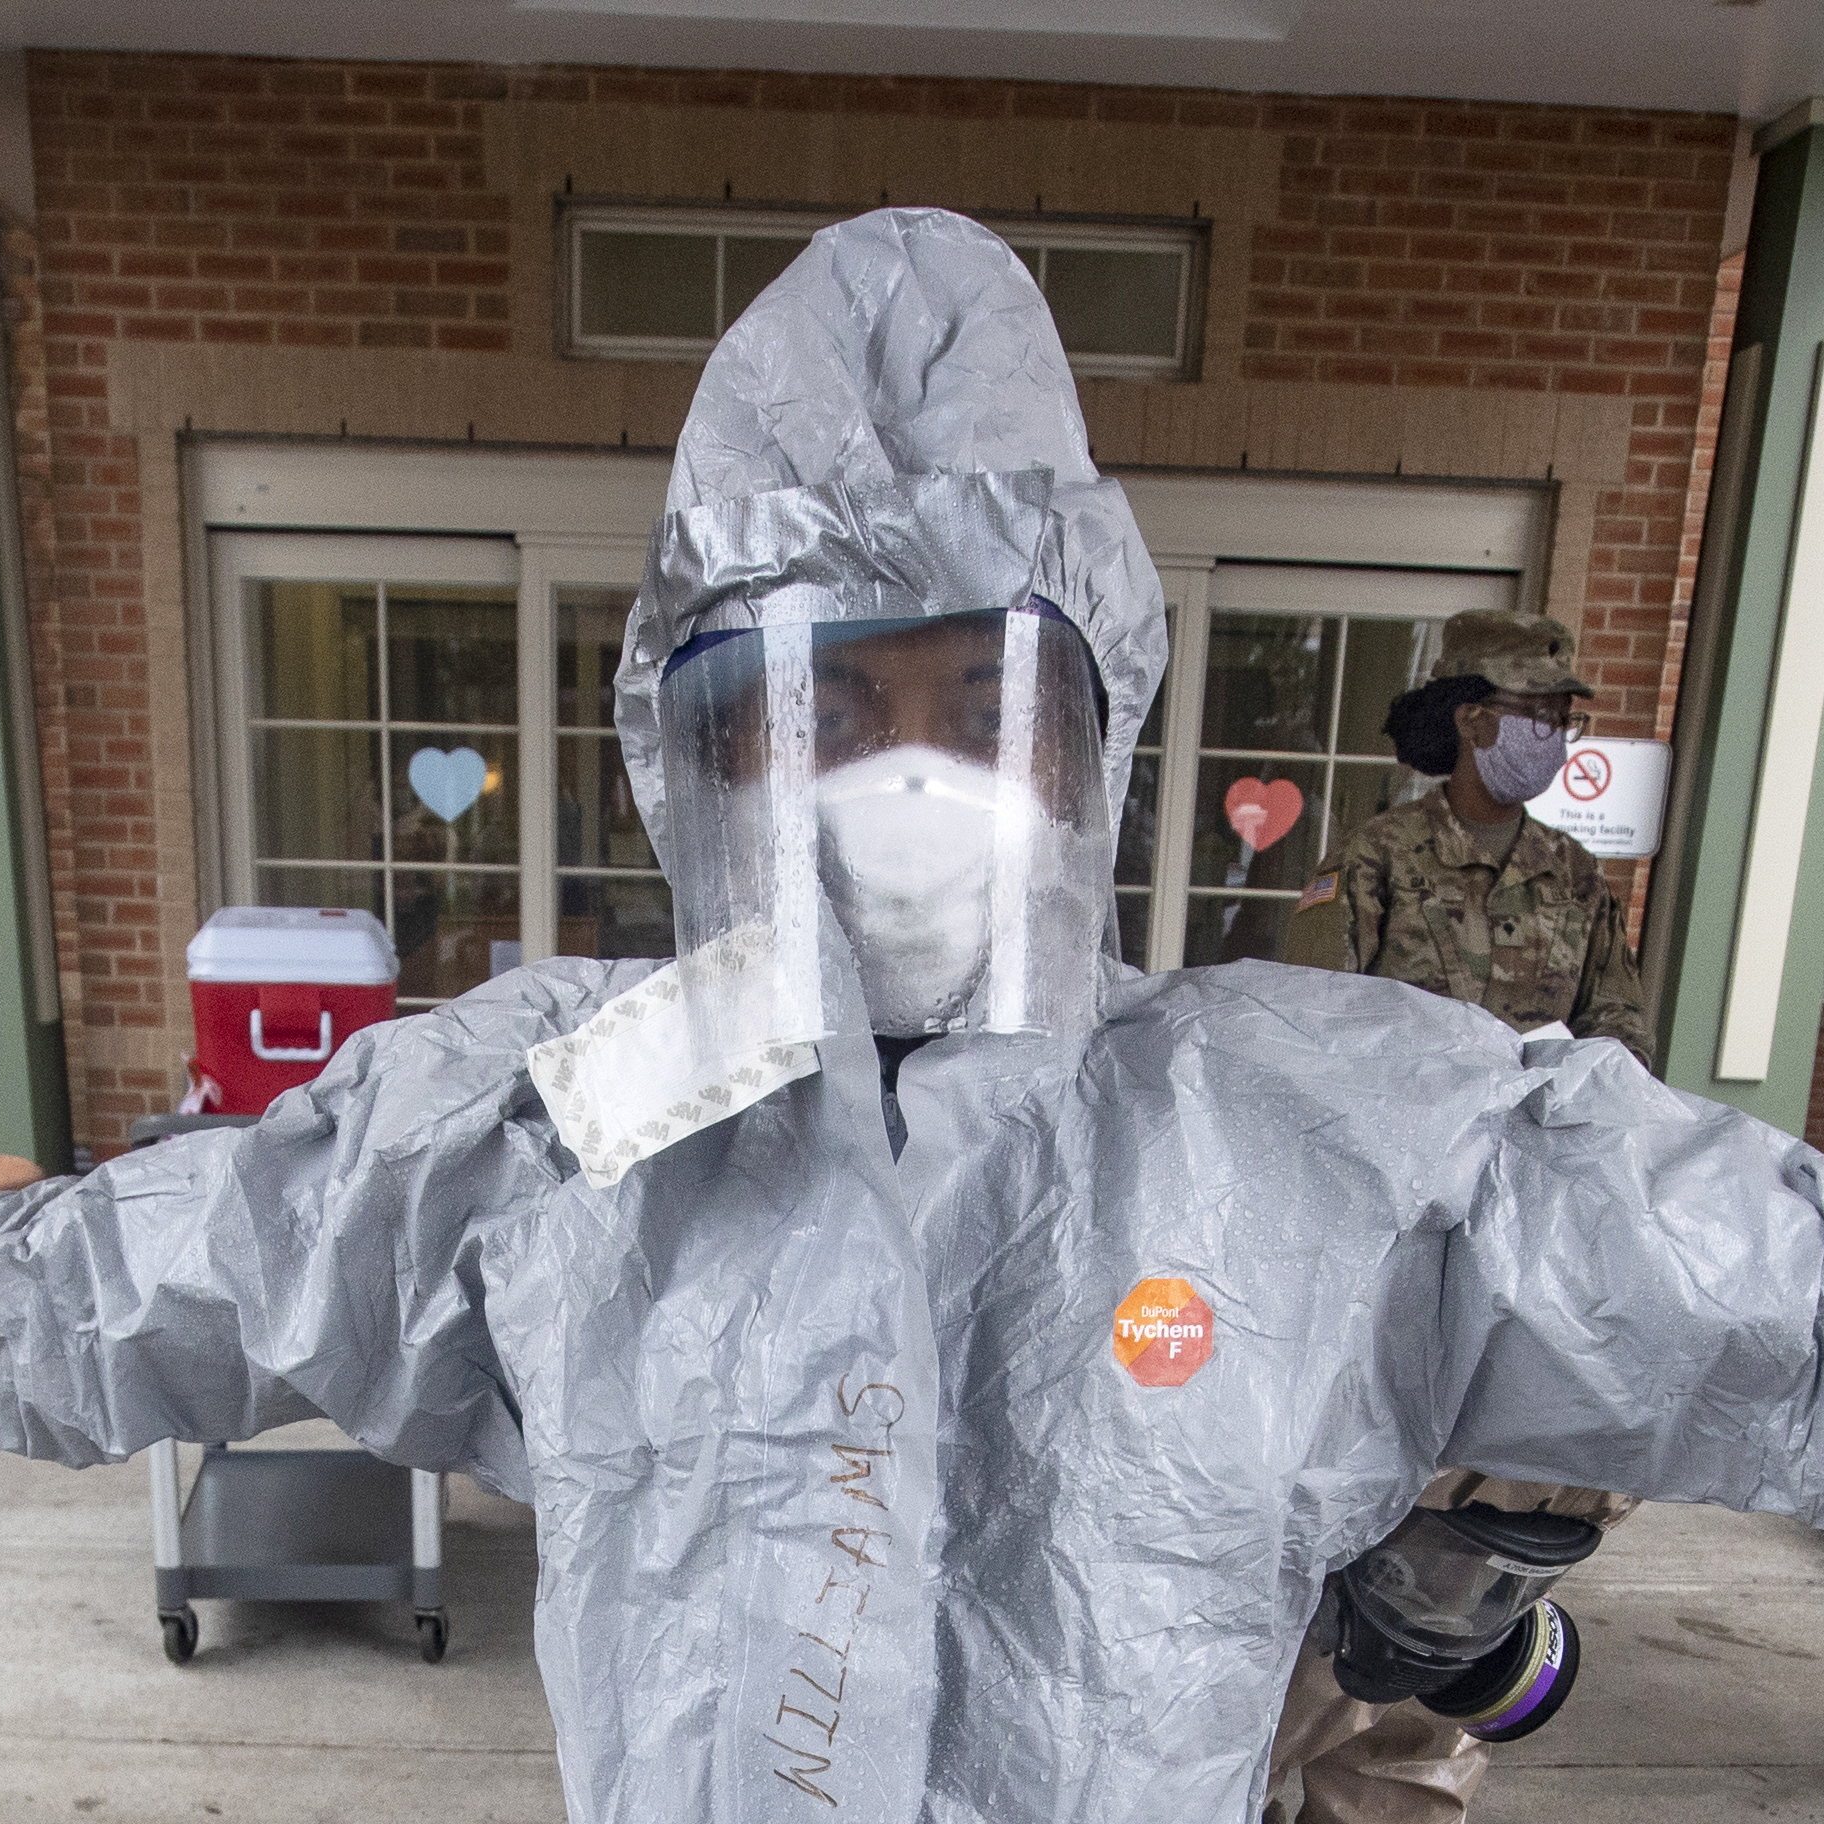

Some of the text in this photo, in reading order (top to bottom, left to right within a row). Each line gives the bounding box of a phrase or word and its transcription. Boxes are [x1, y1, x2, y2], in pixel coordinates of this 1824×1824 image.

[1600, 823, 1636, 837] facility
[613, 1000, 648, 1020] 3M
[645, 980, 680, 1002] 3M
[636, 1120, 670, 1141] 3M
[667, 1101, 703, 1123] 3M
[698, 1084, 732, 1107] 3M
[728, 1067, 763, 1087] 3M
[759, 1046, 794, 1067] 3M
[1141, 1305, 1180, 1318] DuPont
[1118, 1319, 1204, 1343] Tychem
[1168, 1341, 1183, 1359] F
[763, 1372, 906, 1808] WILLIAMS
